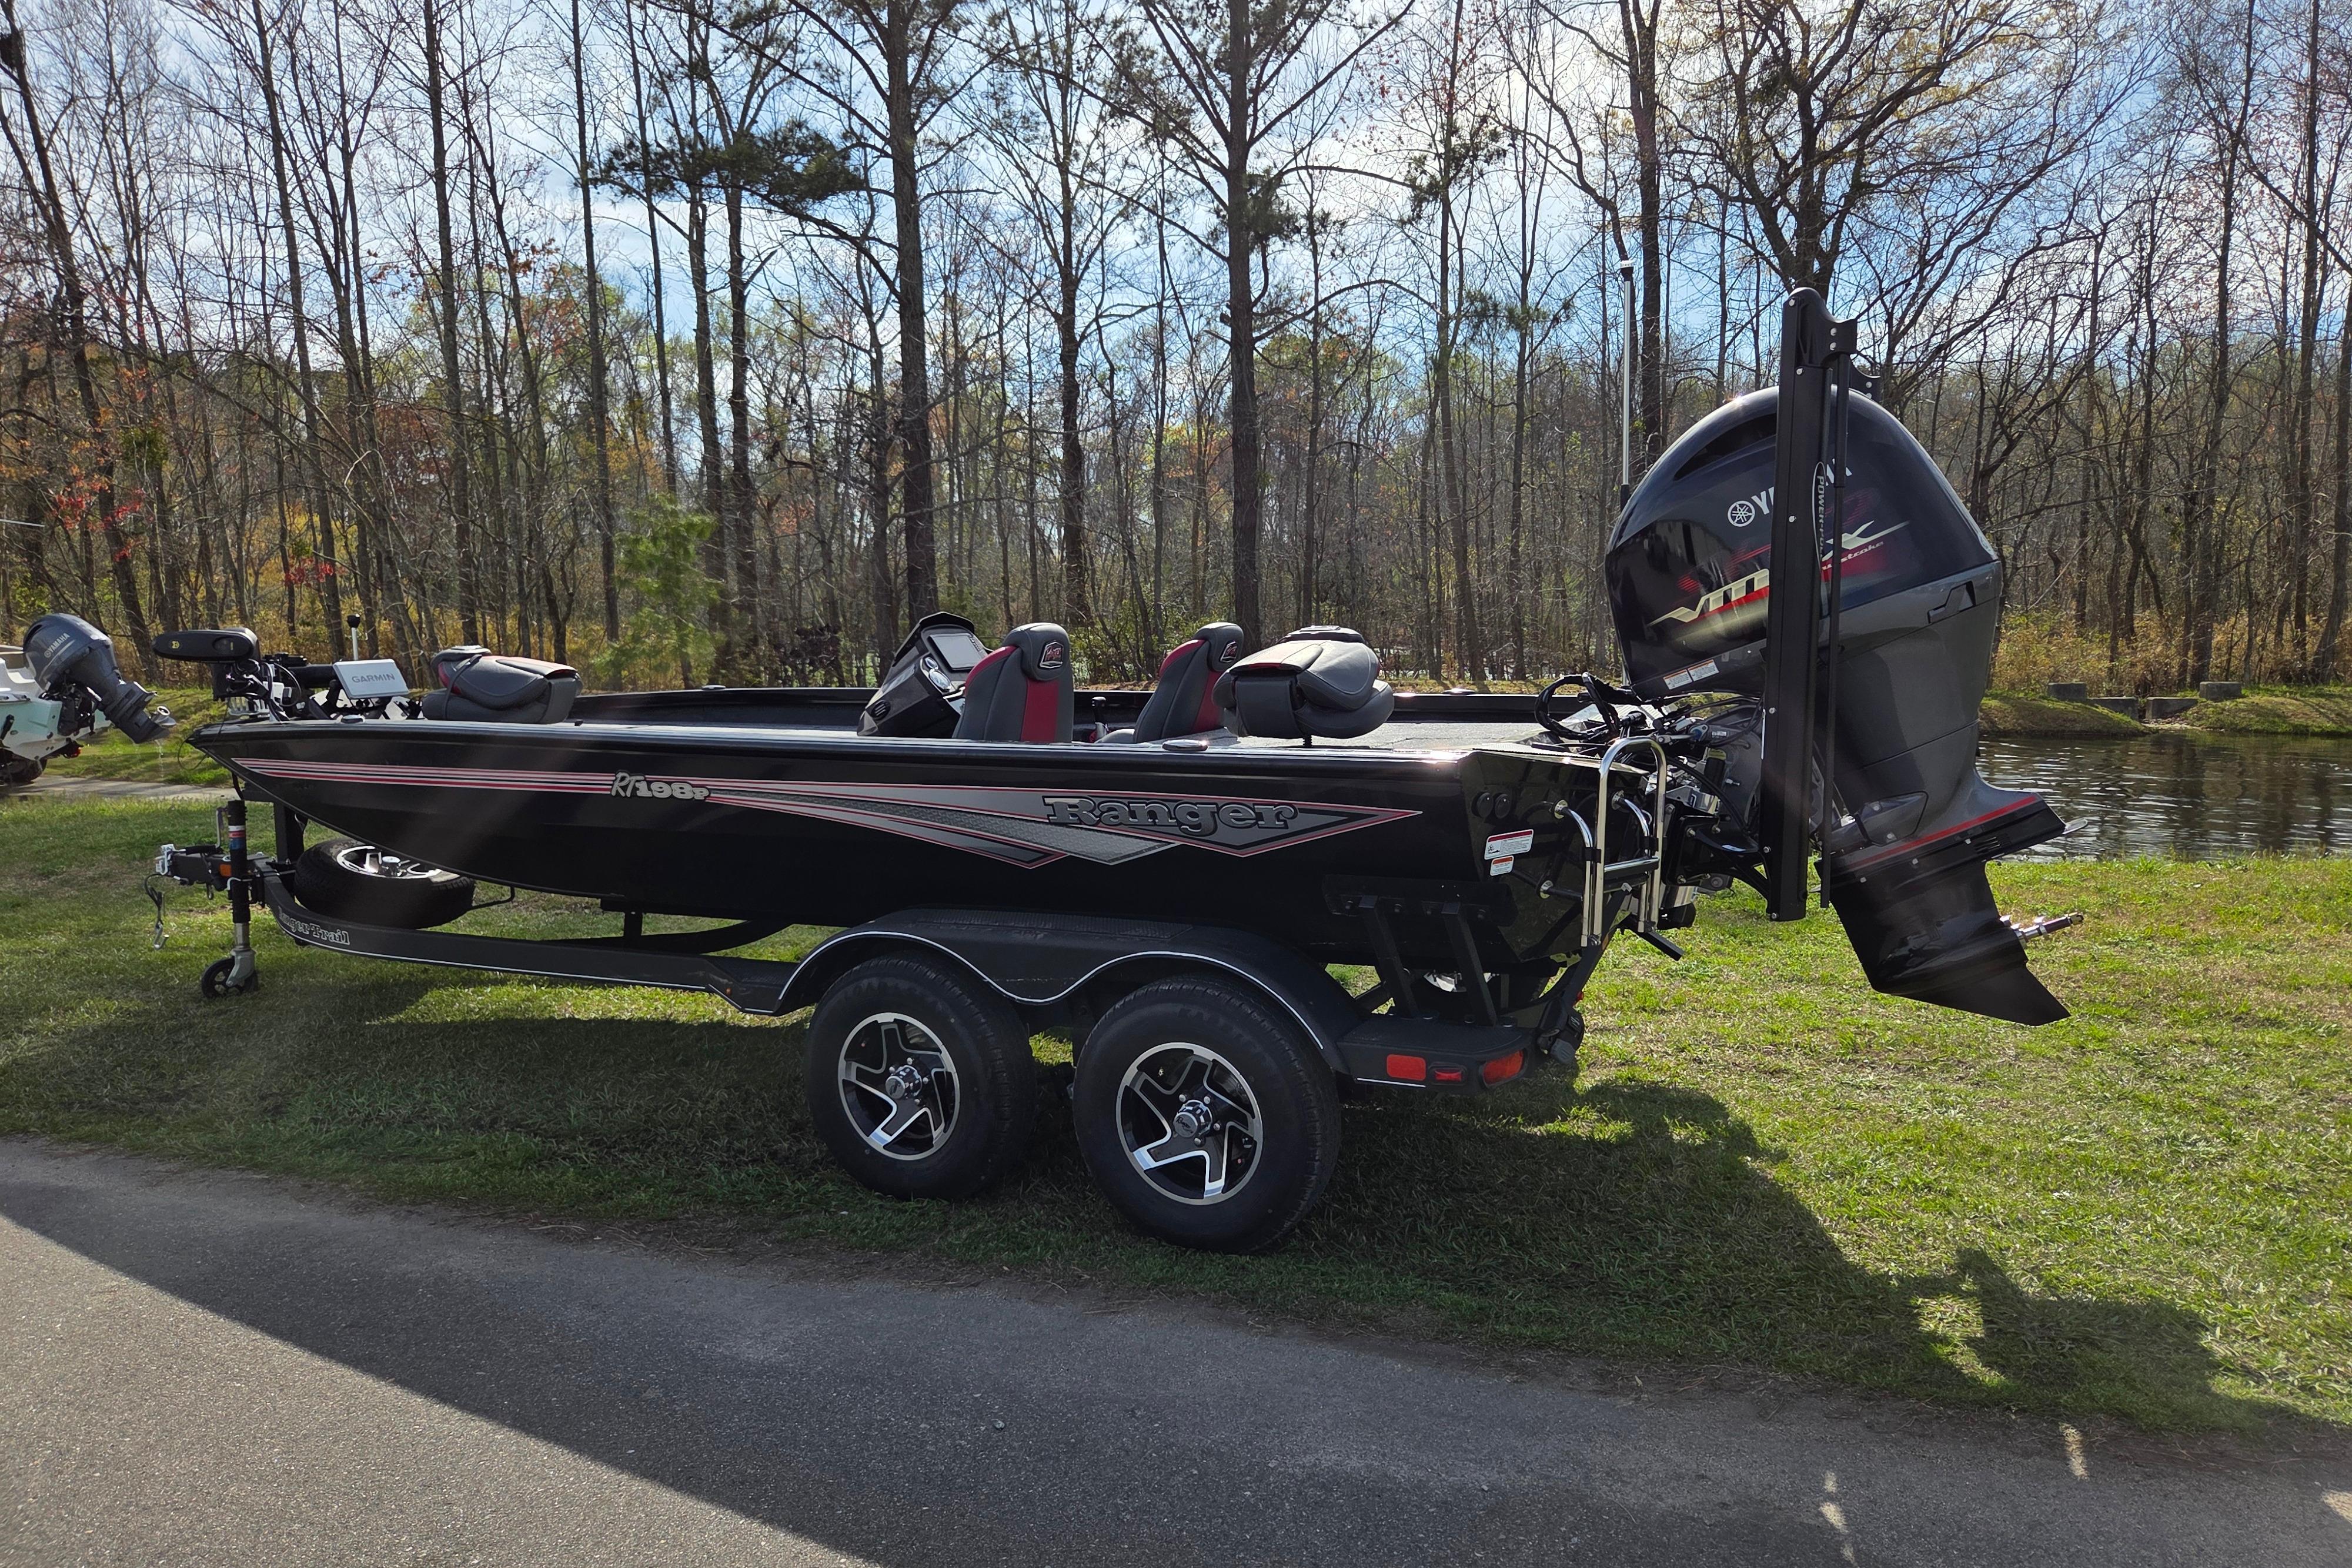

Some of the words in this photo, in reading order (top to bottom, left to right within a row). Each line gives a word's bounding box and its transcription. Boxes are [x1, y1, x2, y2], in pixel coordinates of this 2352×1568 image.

[47, 633, 70, 653] YAMAHA
[352, 673, 395, 683] GARMIN
[611, 771, 709, 800] RT198P
[1042, 795, 1298, 836] Ranger
[309, 923, 350, 945] Trail
